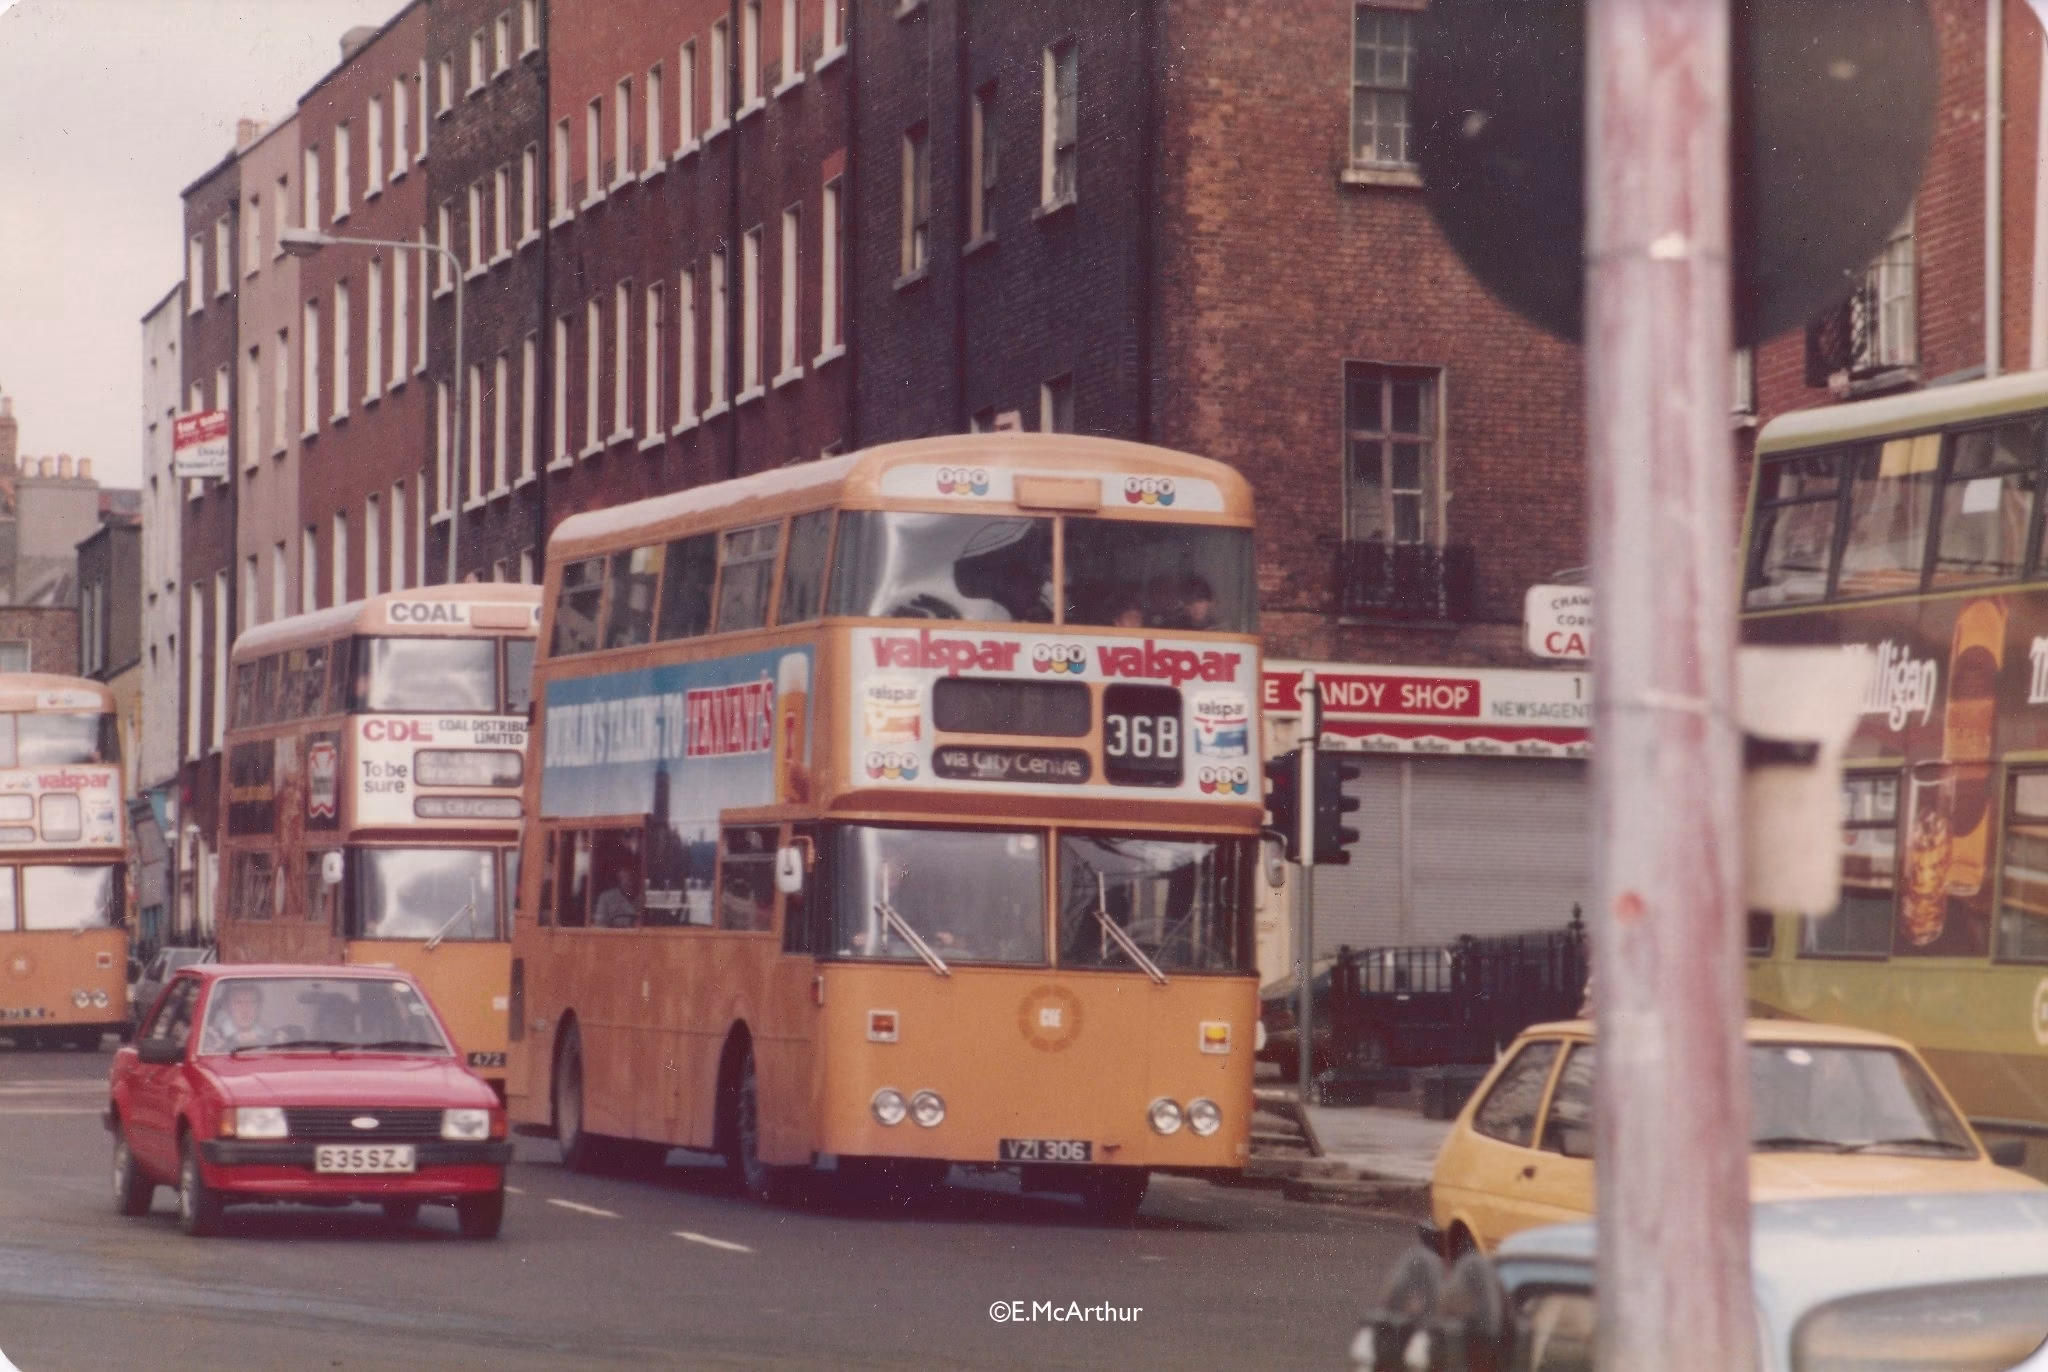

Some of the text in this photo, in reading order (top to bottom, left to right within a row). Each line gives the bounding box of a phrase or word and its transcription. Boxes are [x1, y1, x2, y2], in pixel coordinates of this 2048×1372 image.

[390, 603, 464, 623] COAL
[1556, 614, 1592, 626] COR
[871, 630, 1021, 678] valspar
[1097, 639, 1241, 685] valspar
[1401, 684, 1470, 709] SHOP
[363, 720, 433, 742] CDL
[439, 719, 468, 731] COAL
[475, 733, 524, 744] LIMITED
[1106, 715, 1178, 759] 36B
[362, 760, 382, 777] To
[385, 759, 408, 777] be
[942, 751, 968, 767] via
[972, 751, 1012, 773] City
[37, 768, 111, 791] valspar
[364, 779, 405, 794] sure
[473, 1053, 501, 1067] 472
[1044, 1141, 1085, 1160] 306
